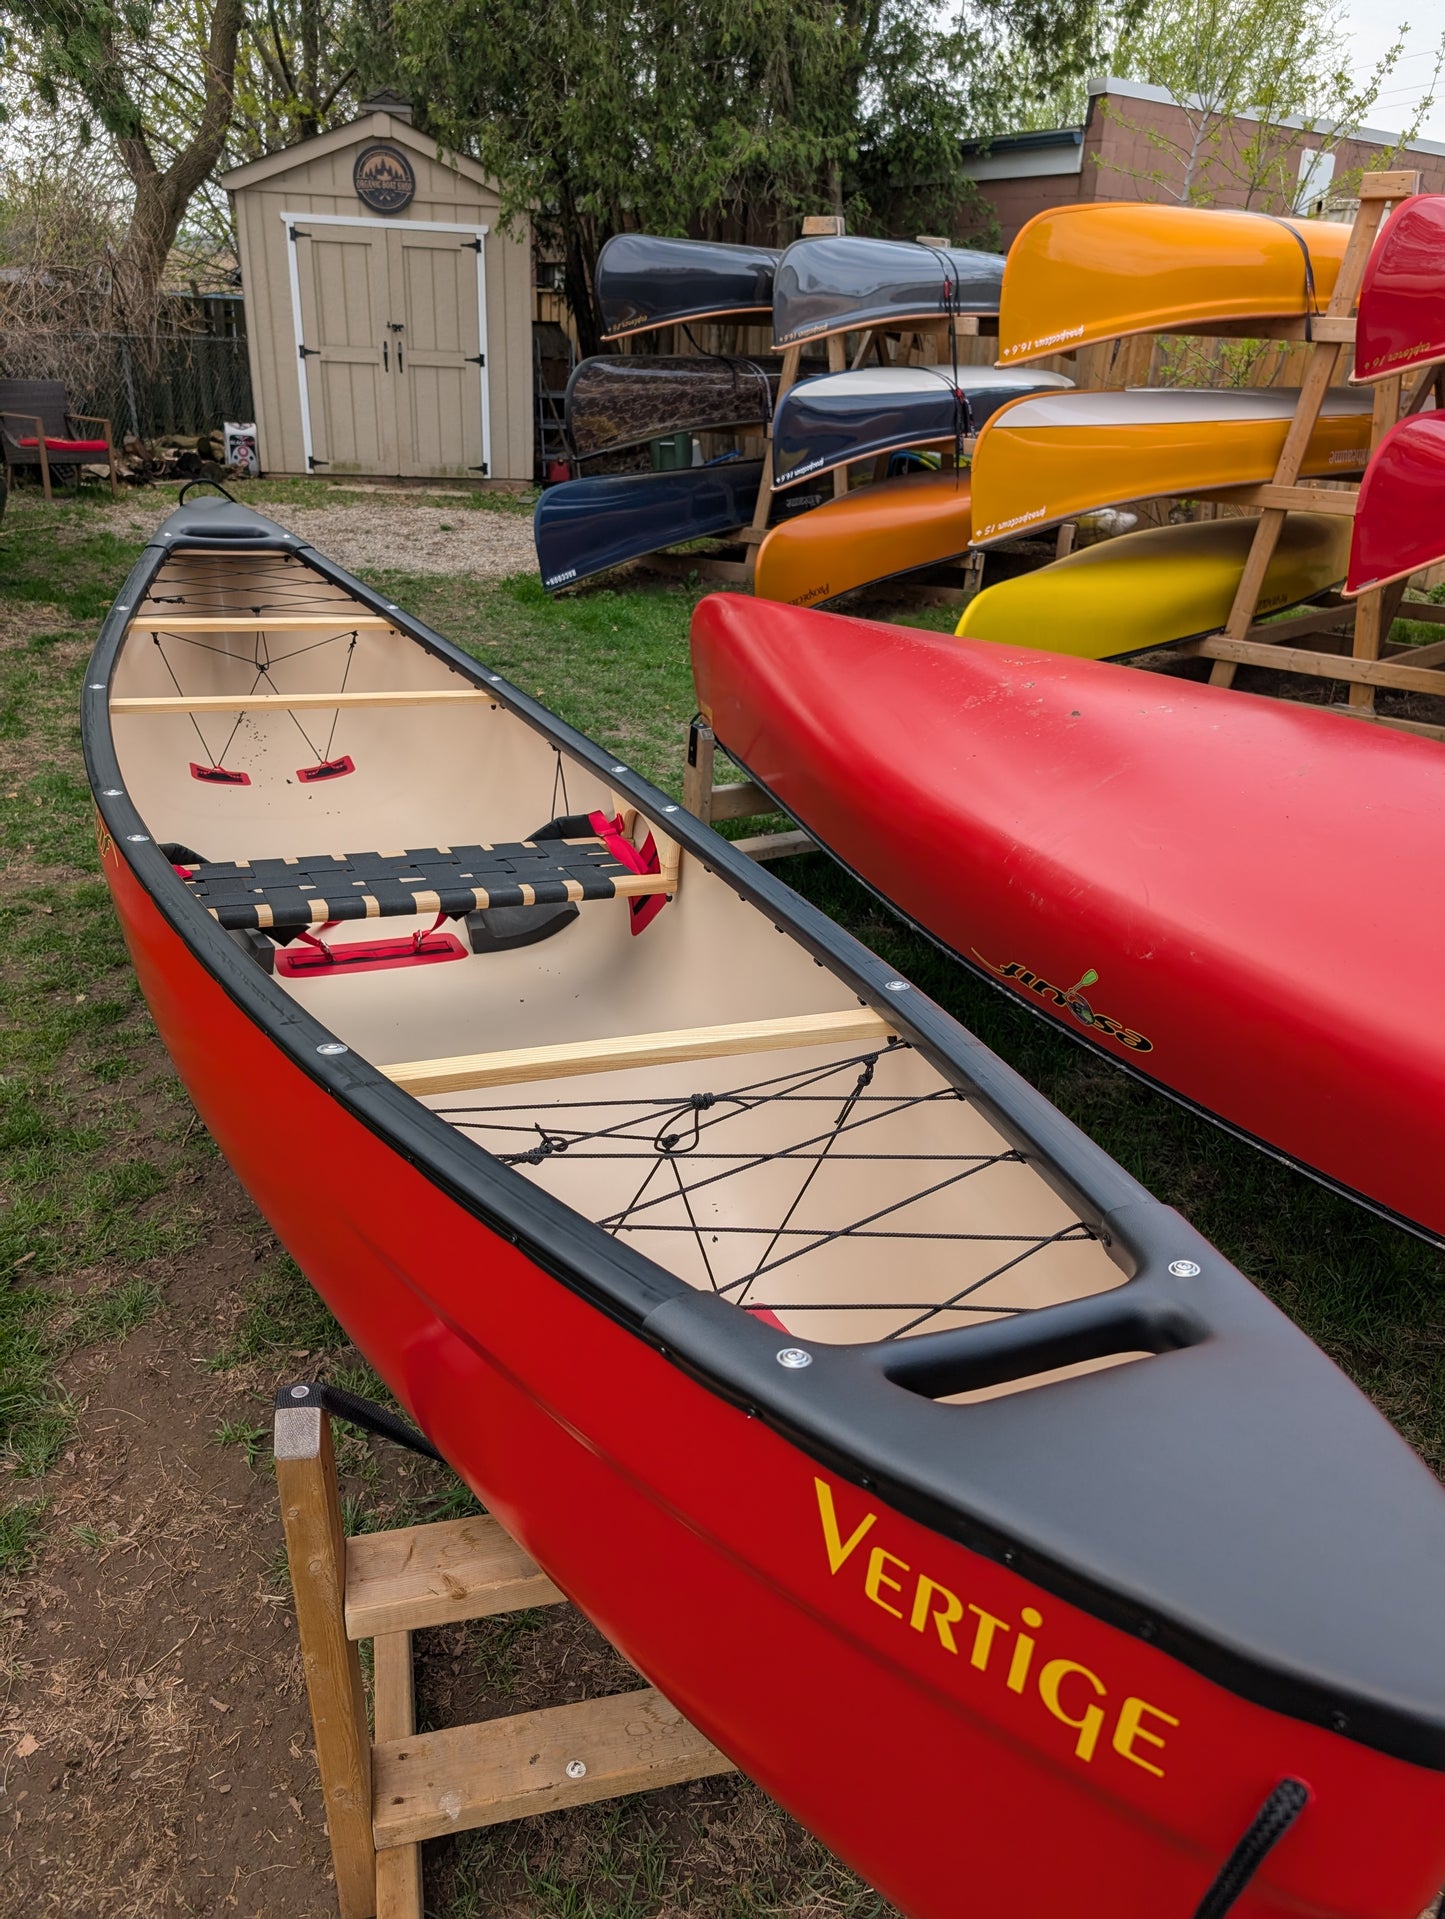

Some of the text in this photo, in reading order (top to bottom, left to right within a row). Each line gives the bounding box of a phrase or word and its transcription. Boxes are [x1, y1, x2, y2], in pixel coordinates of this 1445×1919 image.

[1011, 341, 1032, 355] 16.6
[1372, 355, 1386, 367] 16
[983, 524, 996, 536] 15
